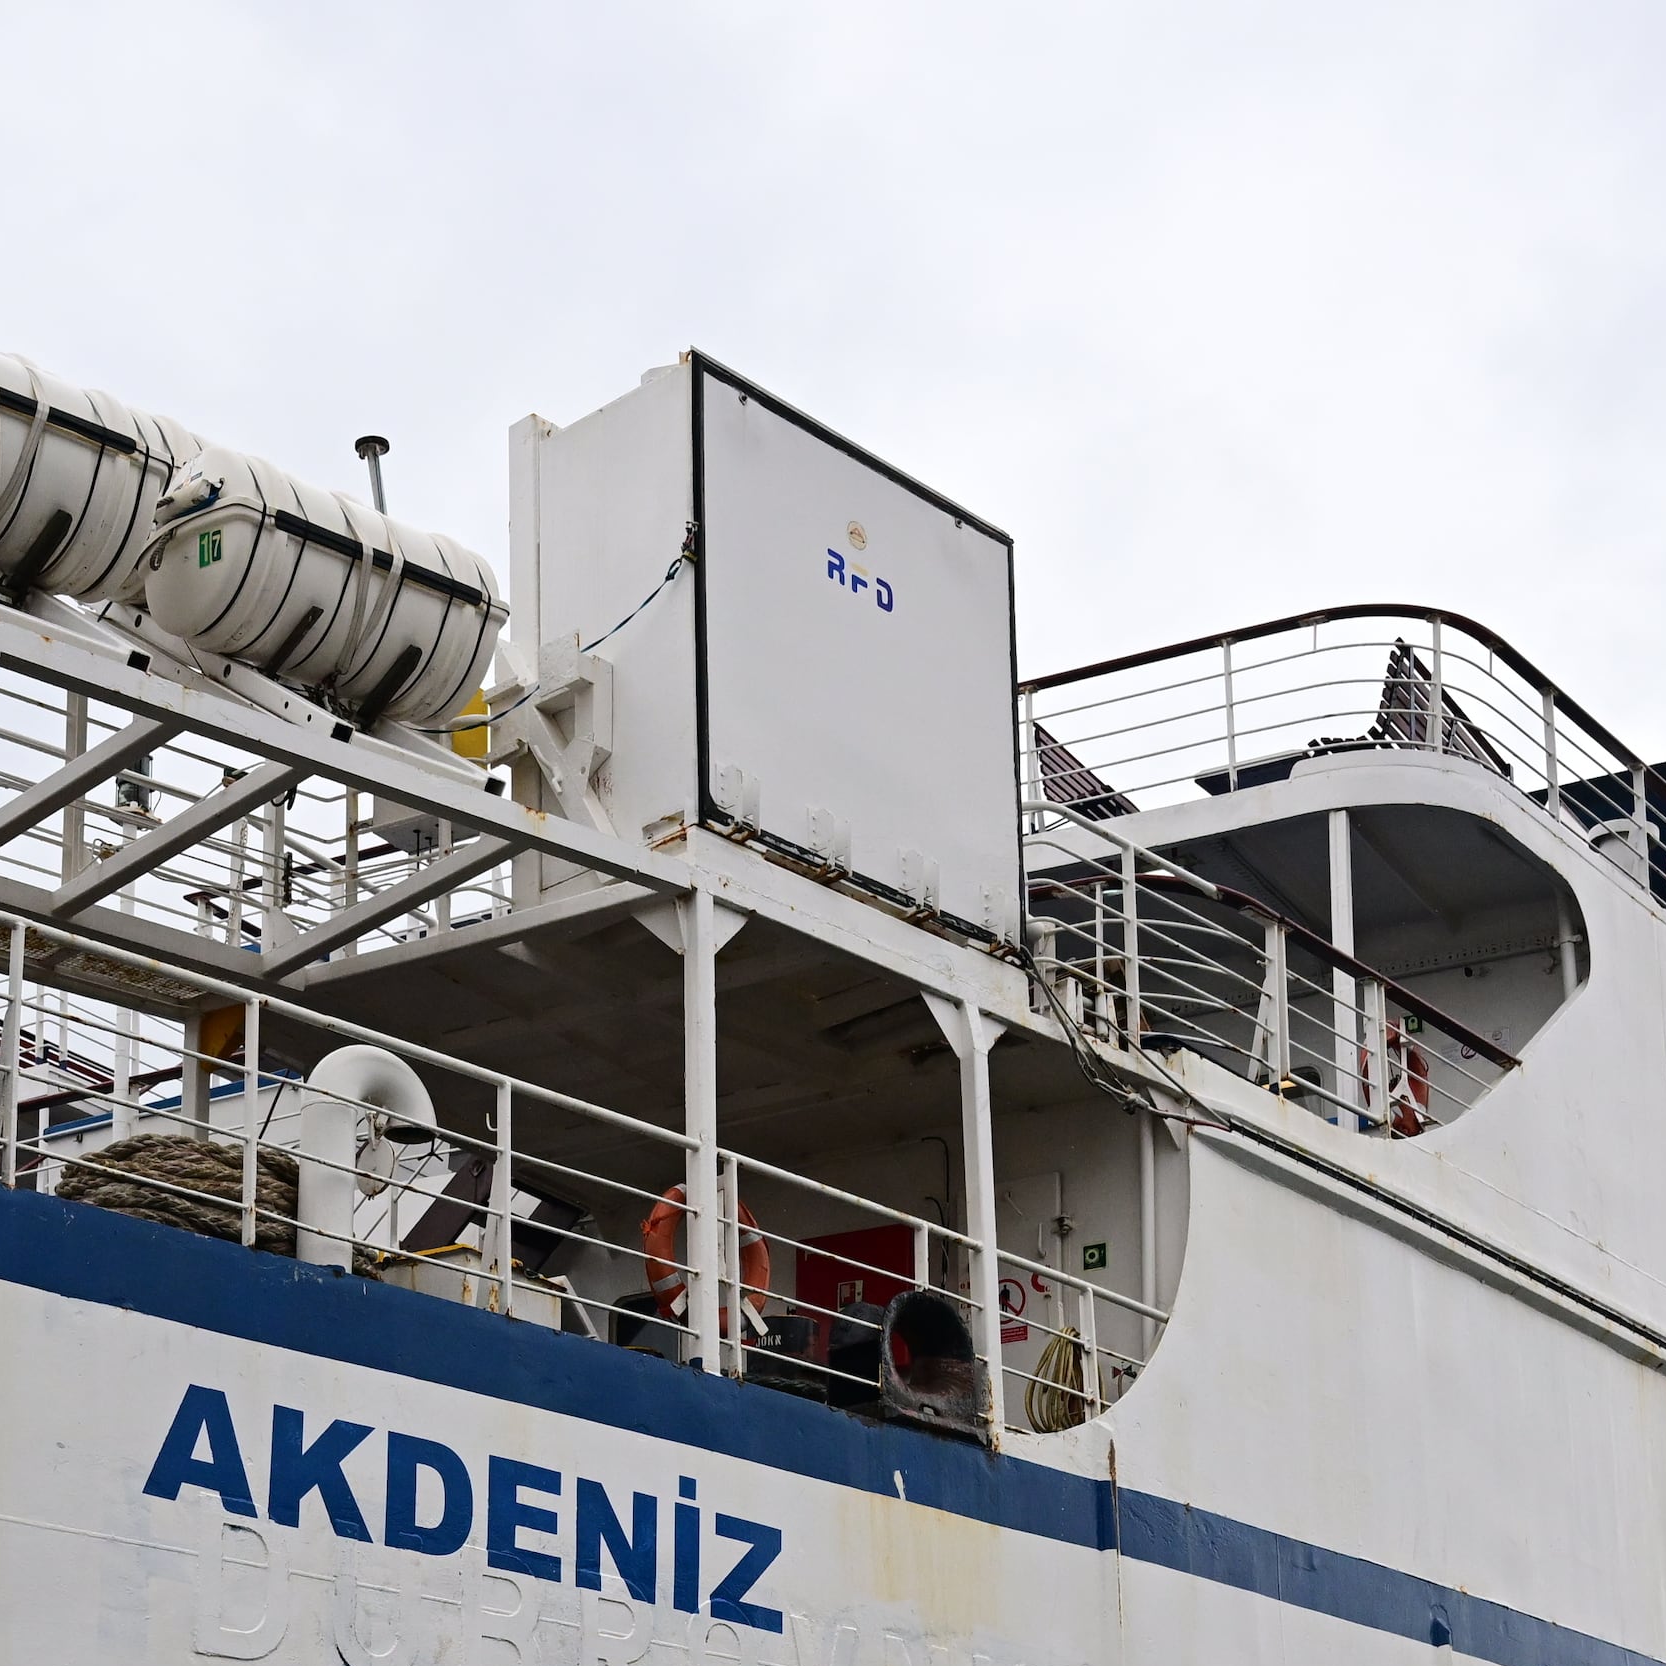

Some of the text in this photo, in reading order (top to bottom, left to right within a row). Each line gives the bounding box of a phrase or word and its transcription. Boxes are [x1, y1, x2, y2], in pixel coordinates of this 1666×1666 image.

[199, 531, 221, 566] 17
[827, 547, 894, 613] RFD
[142, 1384, 783, 1635] AKDENİZ
